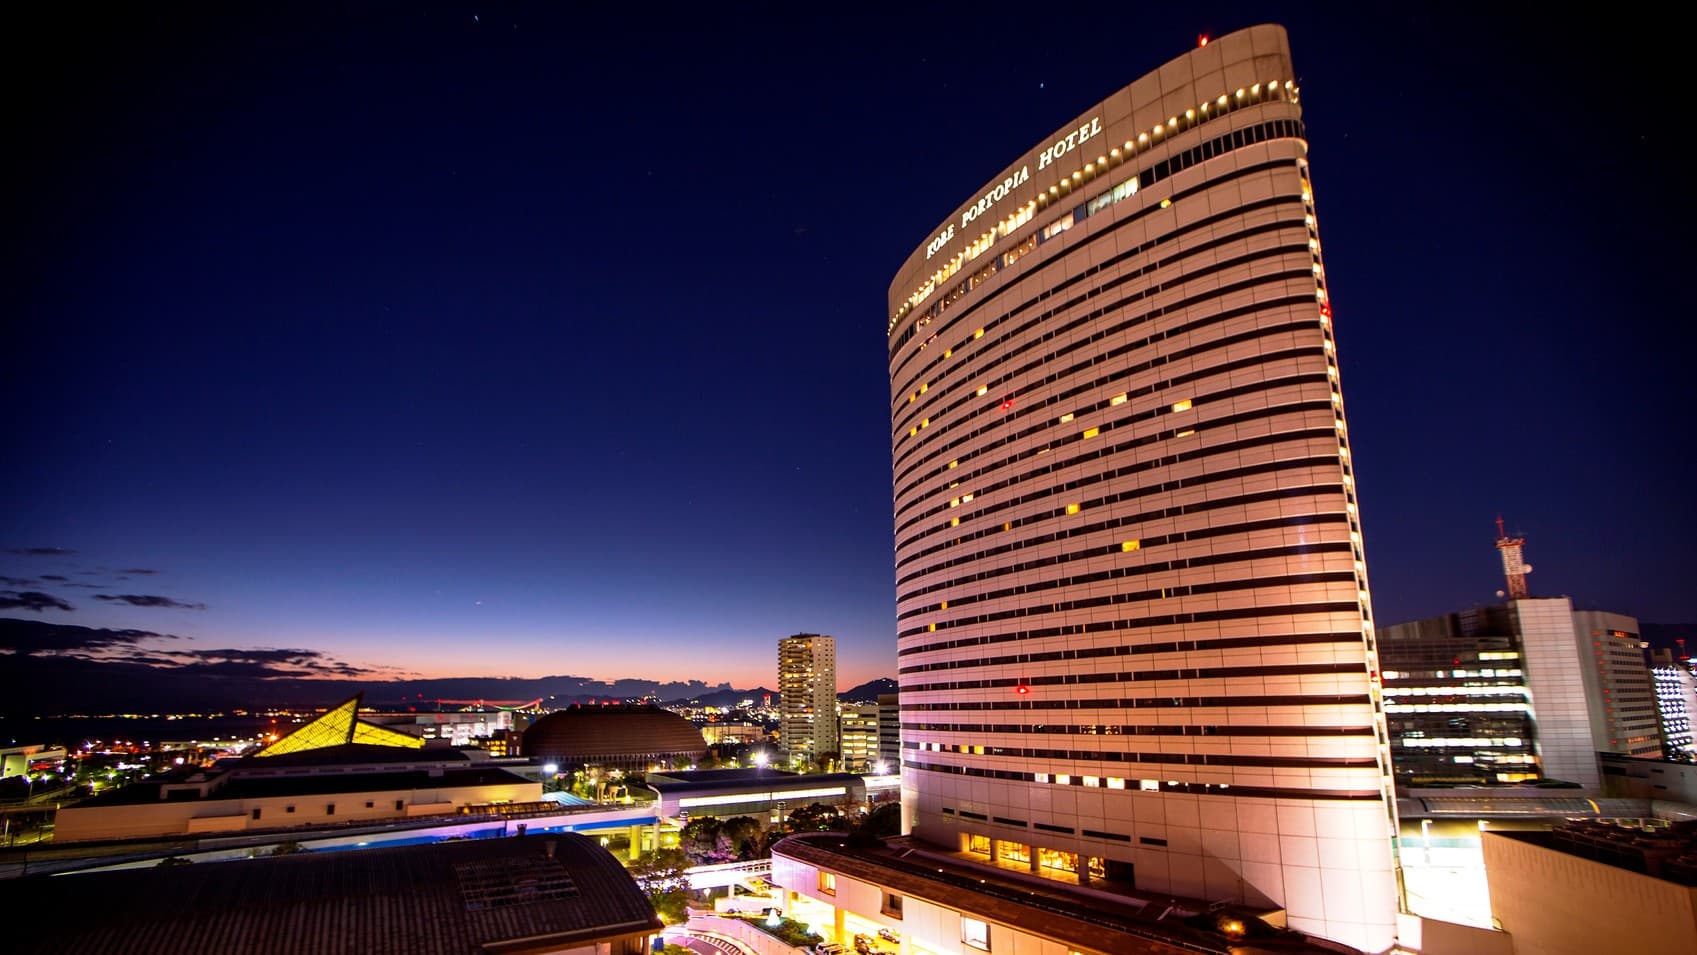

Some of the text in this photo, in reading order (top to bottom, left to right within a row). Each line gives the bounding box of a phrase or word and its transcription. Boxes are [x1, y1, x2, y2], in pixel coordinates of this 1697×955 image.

[926, 116, 1102, 260] KOBE PORTOPIA HOTEL
